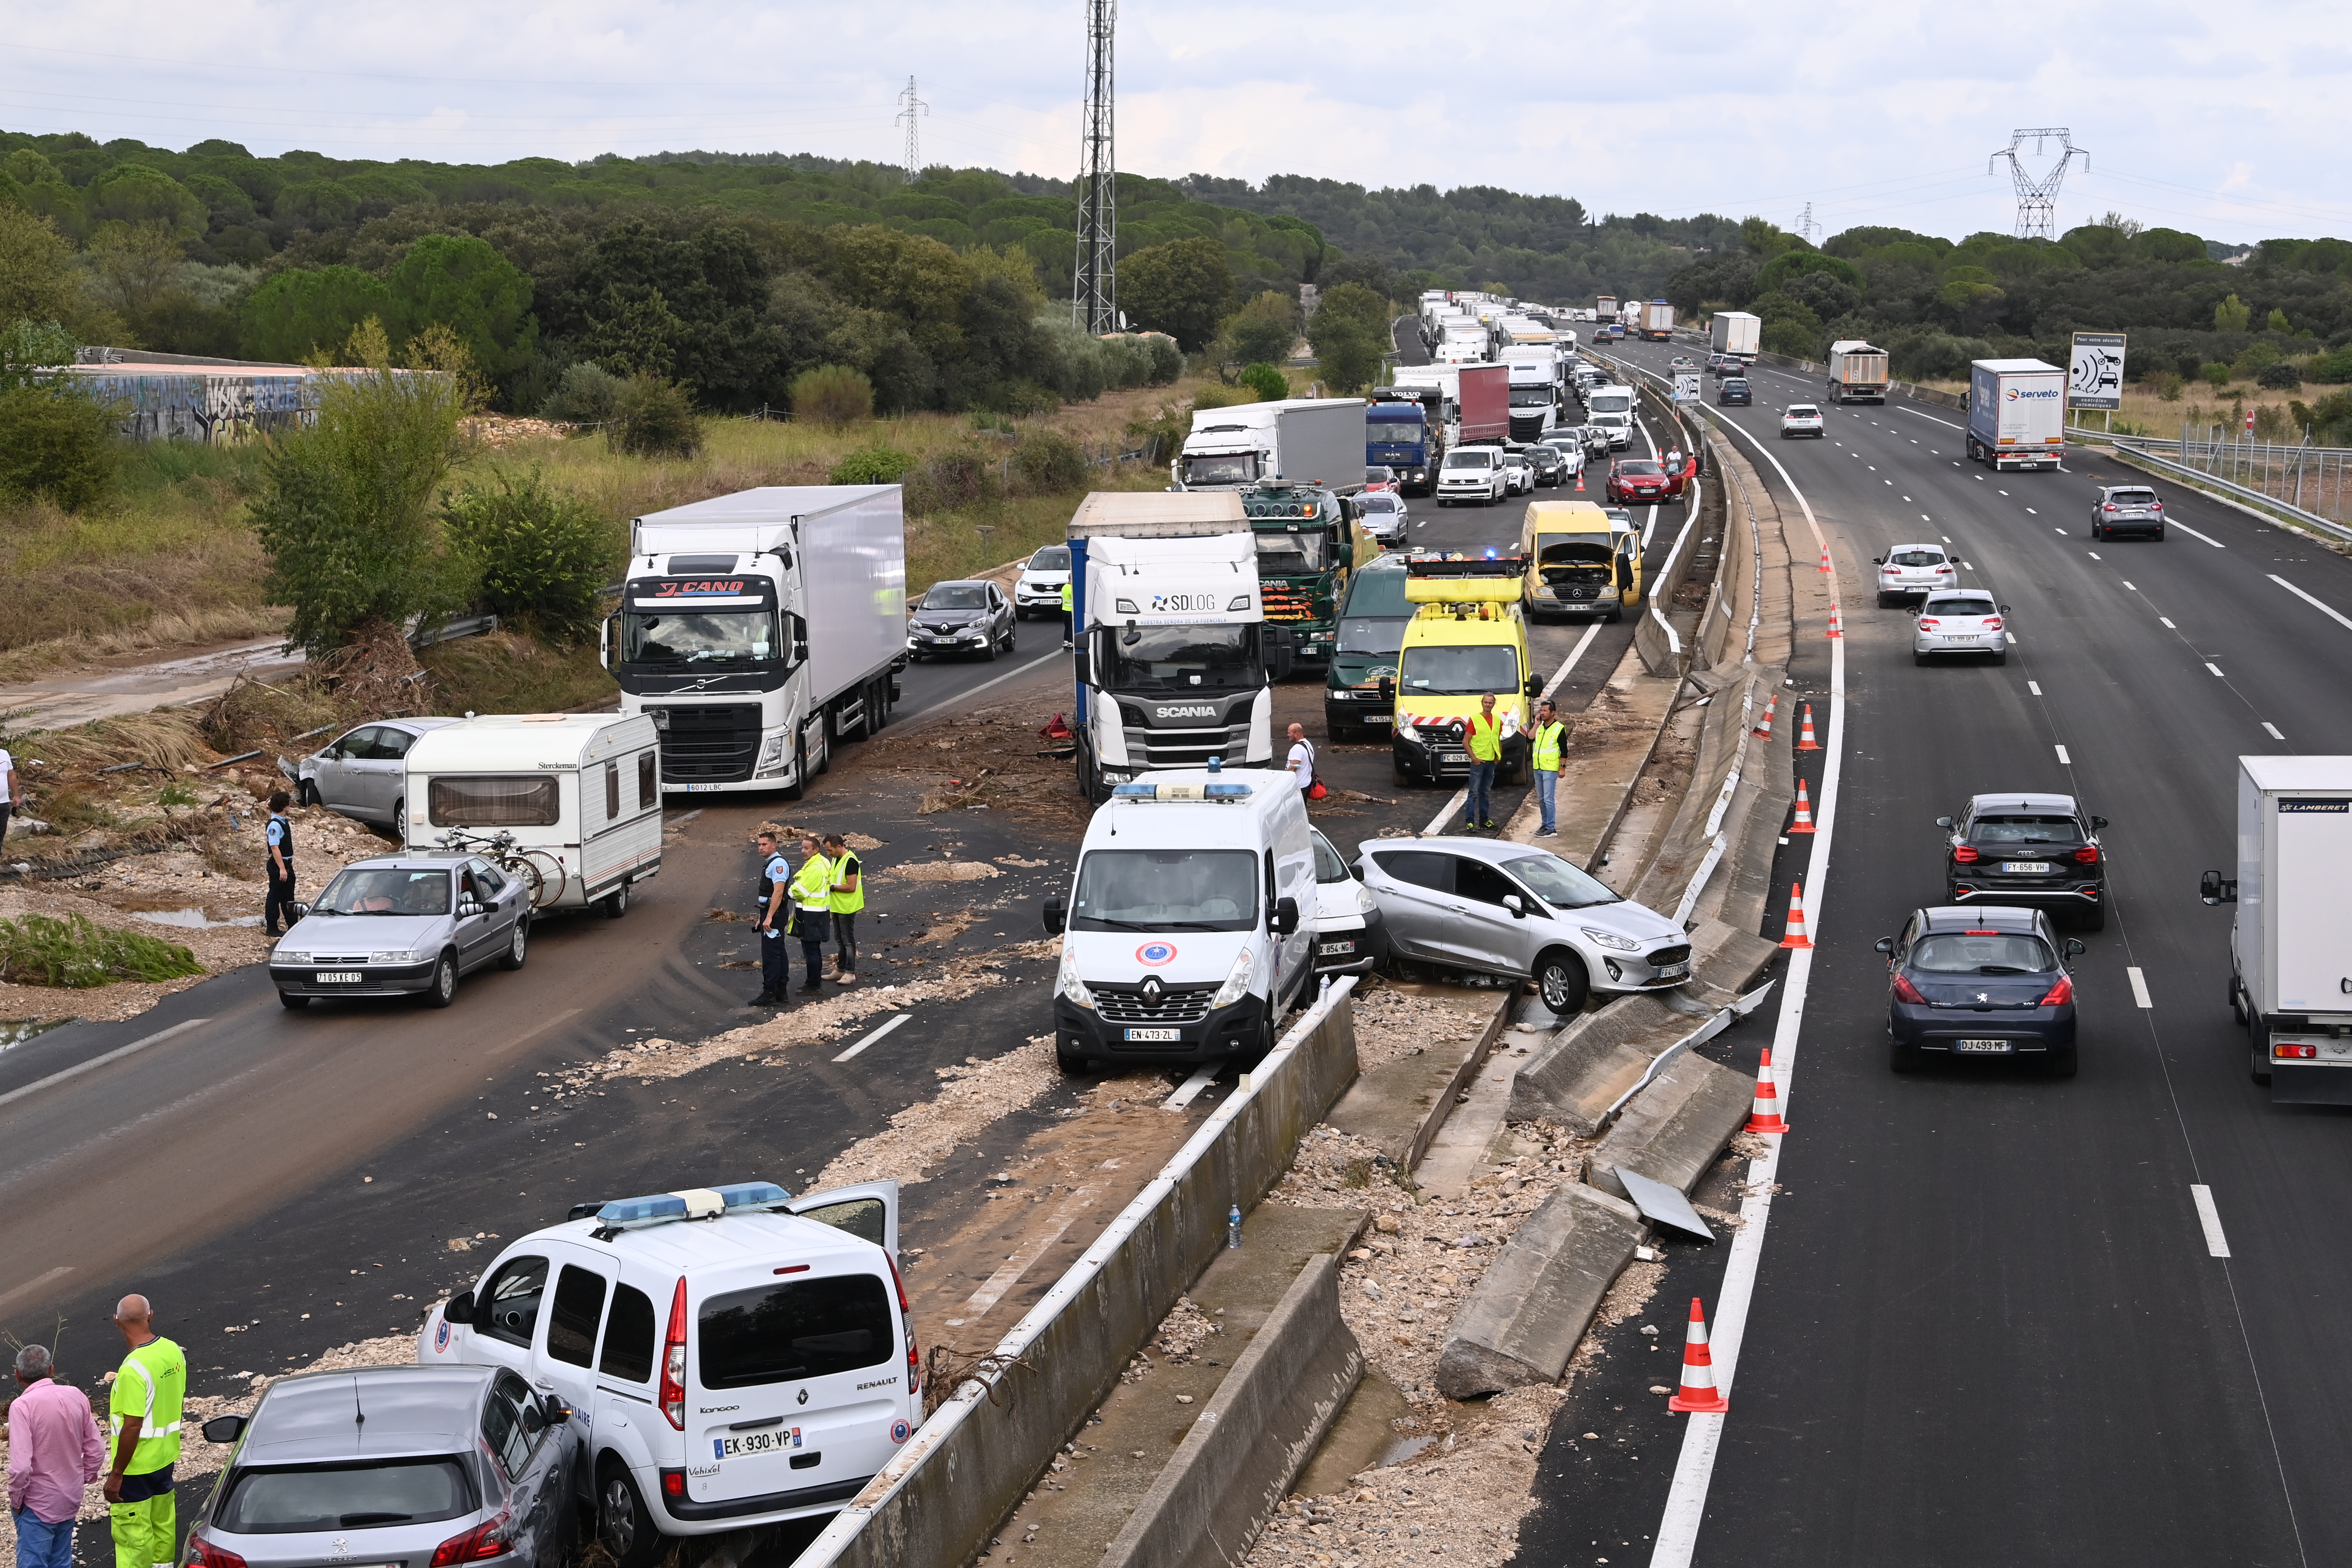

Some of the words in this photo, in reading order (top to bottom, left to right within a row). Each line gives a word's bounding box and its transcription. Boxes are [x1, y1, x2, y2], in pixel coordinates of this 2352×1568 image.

[2020, 389, 2058, 398] serveto
[683, 581, 744, 591] CANO
[1171, 594, 1215, 611] SDLOG
[1157, 706, 1216, 718] SCANIA
[1132, 1031, 1173, 1039] EN-473-ZL
[1962, 1041, 2005, 1050] DJ-493-MF
[857, 1377, 898, 1391] RENAULT
[700, 1405, 740, 1414] Kangoo
[724, 1431, 790, 1454] EK-930-VP
[689, 1464, 721, 1475] Vehixel
